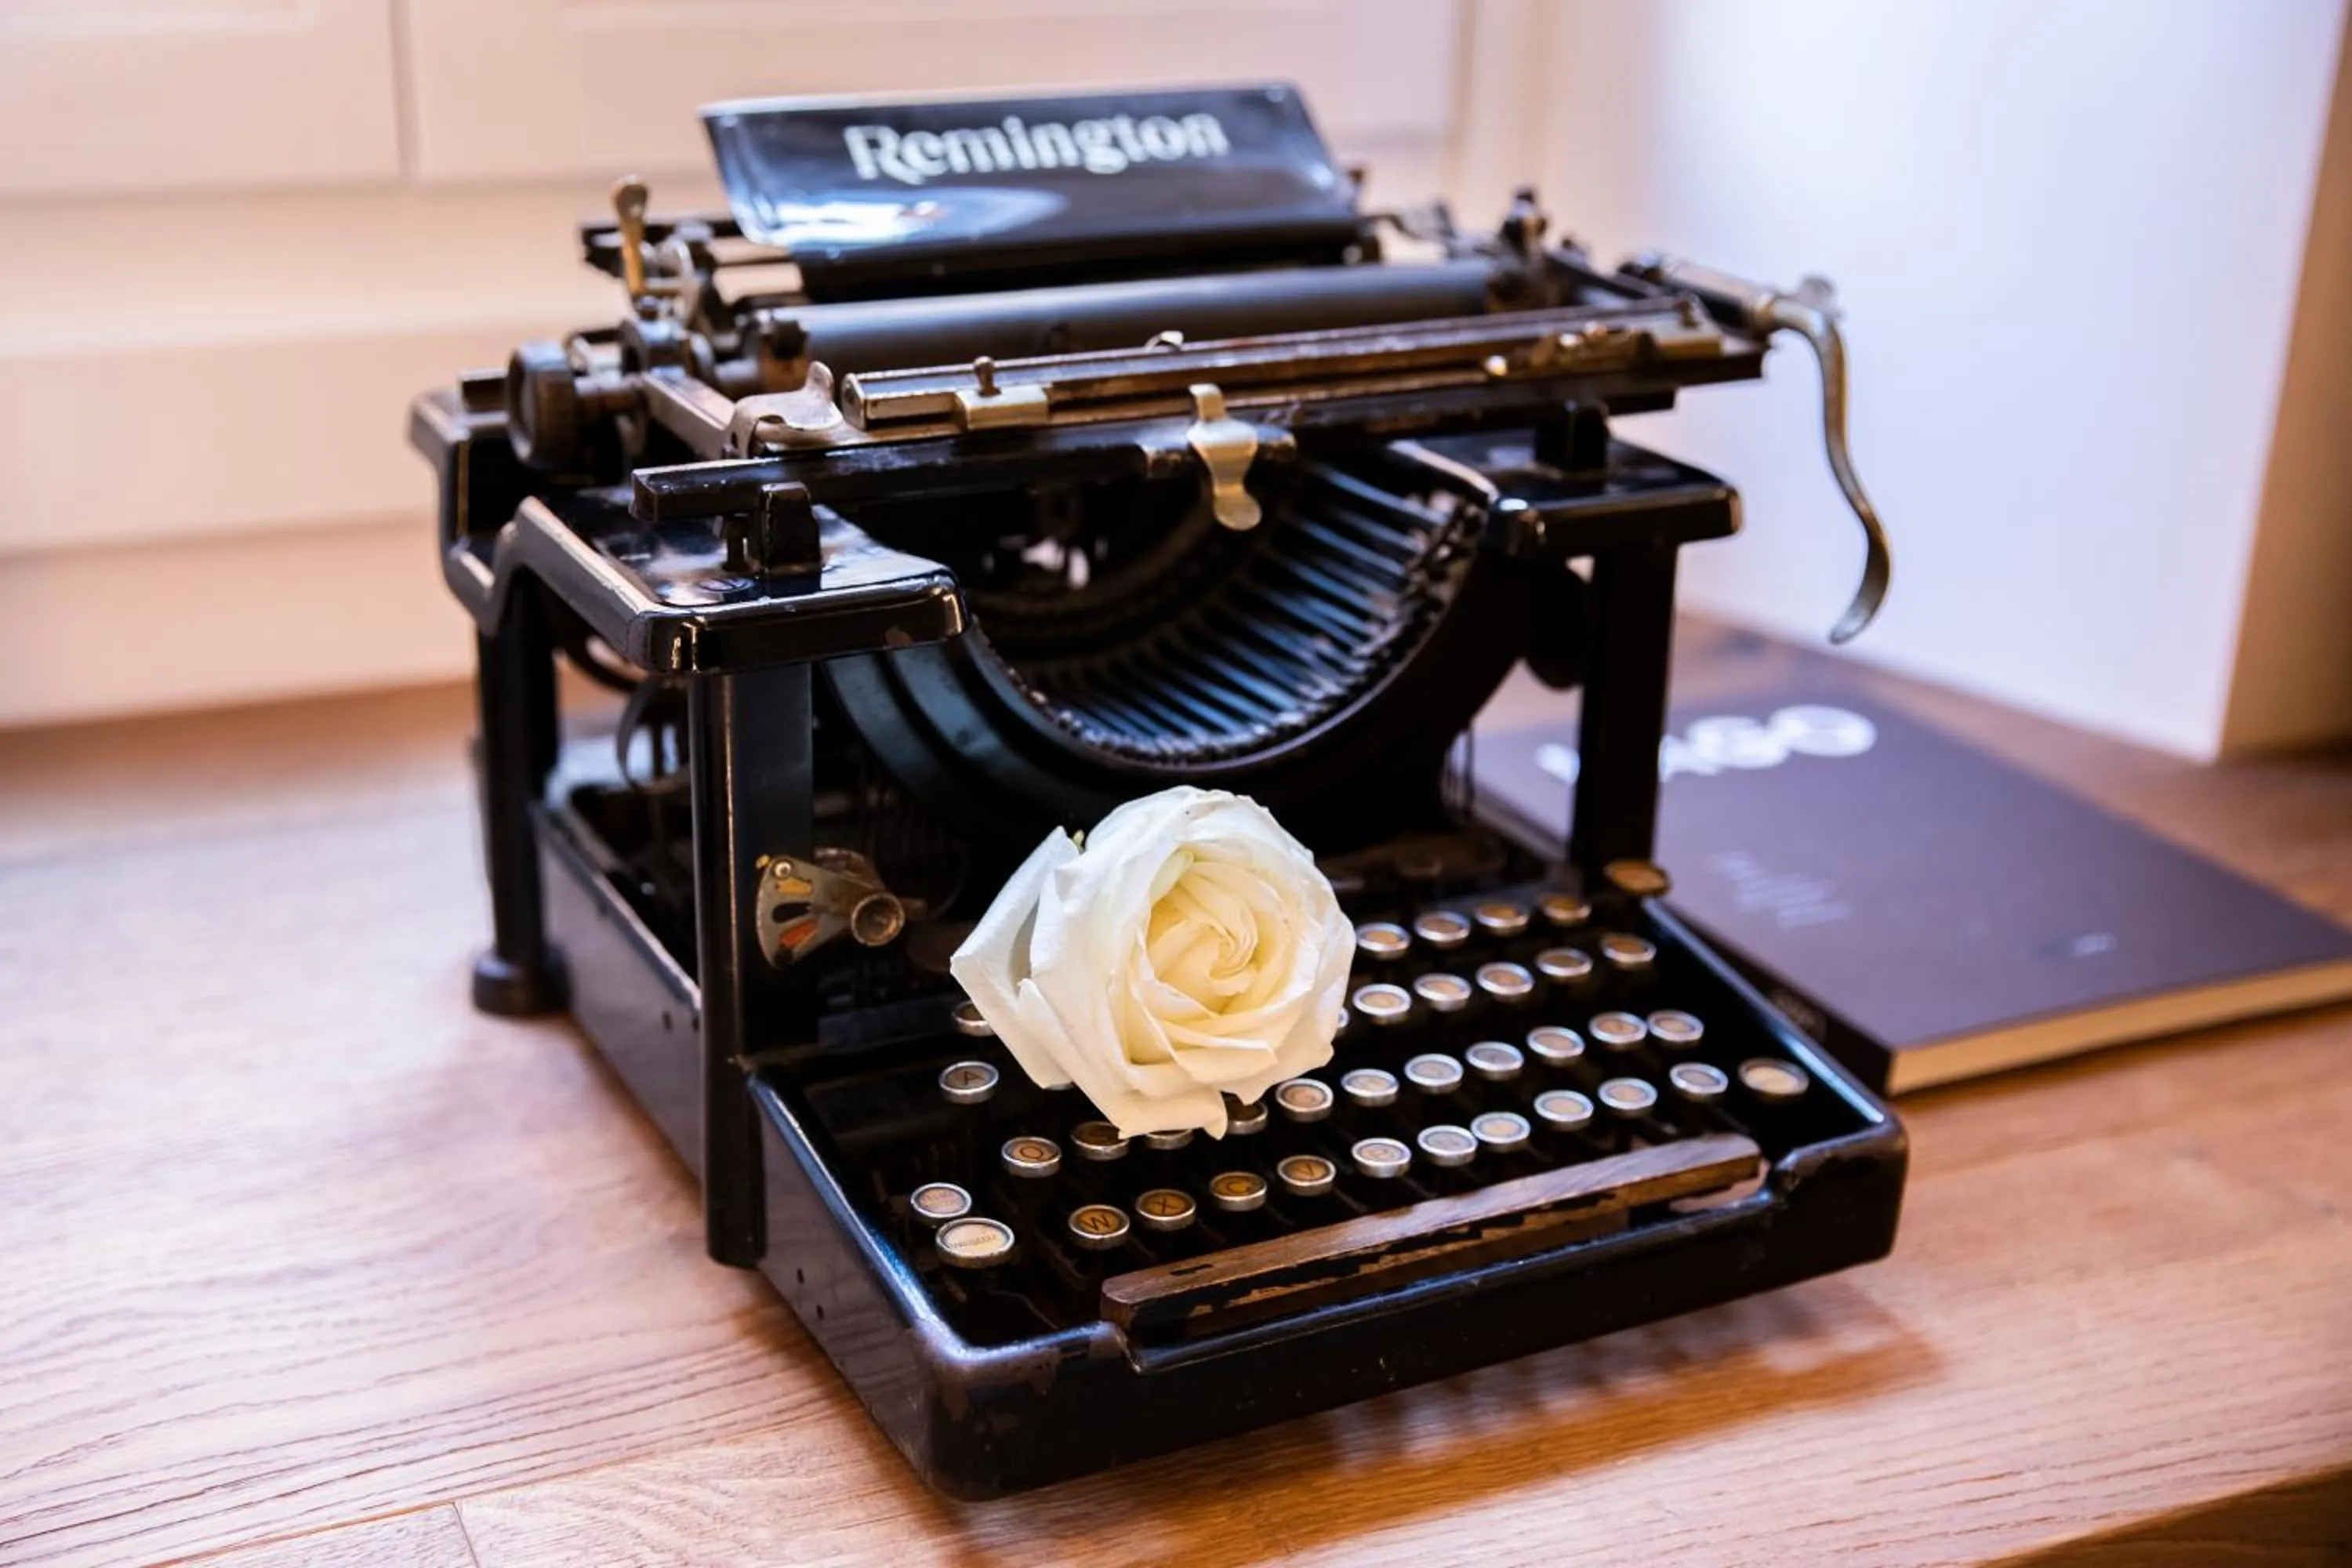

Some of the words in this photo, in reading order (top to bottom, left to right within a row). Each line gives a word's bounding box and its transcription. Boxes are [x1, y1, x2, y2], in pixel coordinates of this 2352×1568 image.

[843, 113, 1230, 186] Remington
[964, 1070, 988, 1087] A
[1080, 1213, 1111, 1231] W
[1150, 1196, 1179, 1214] X
